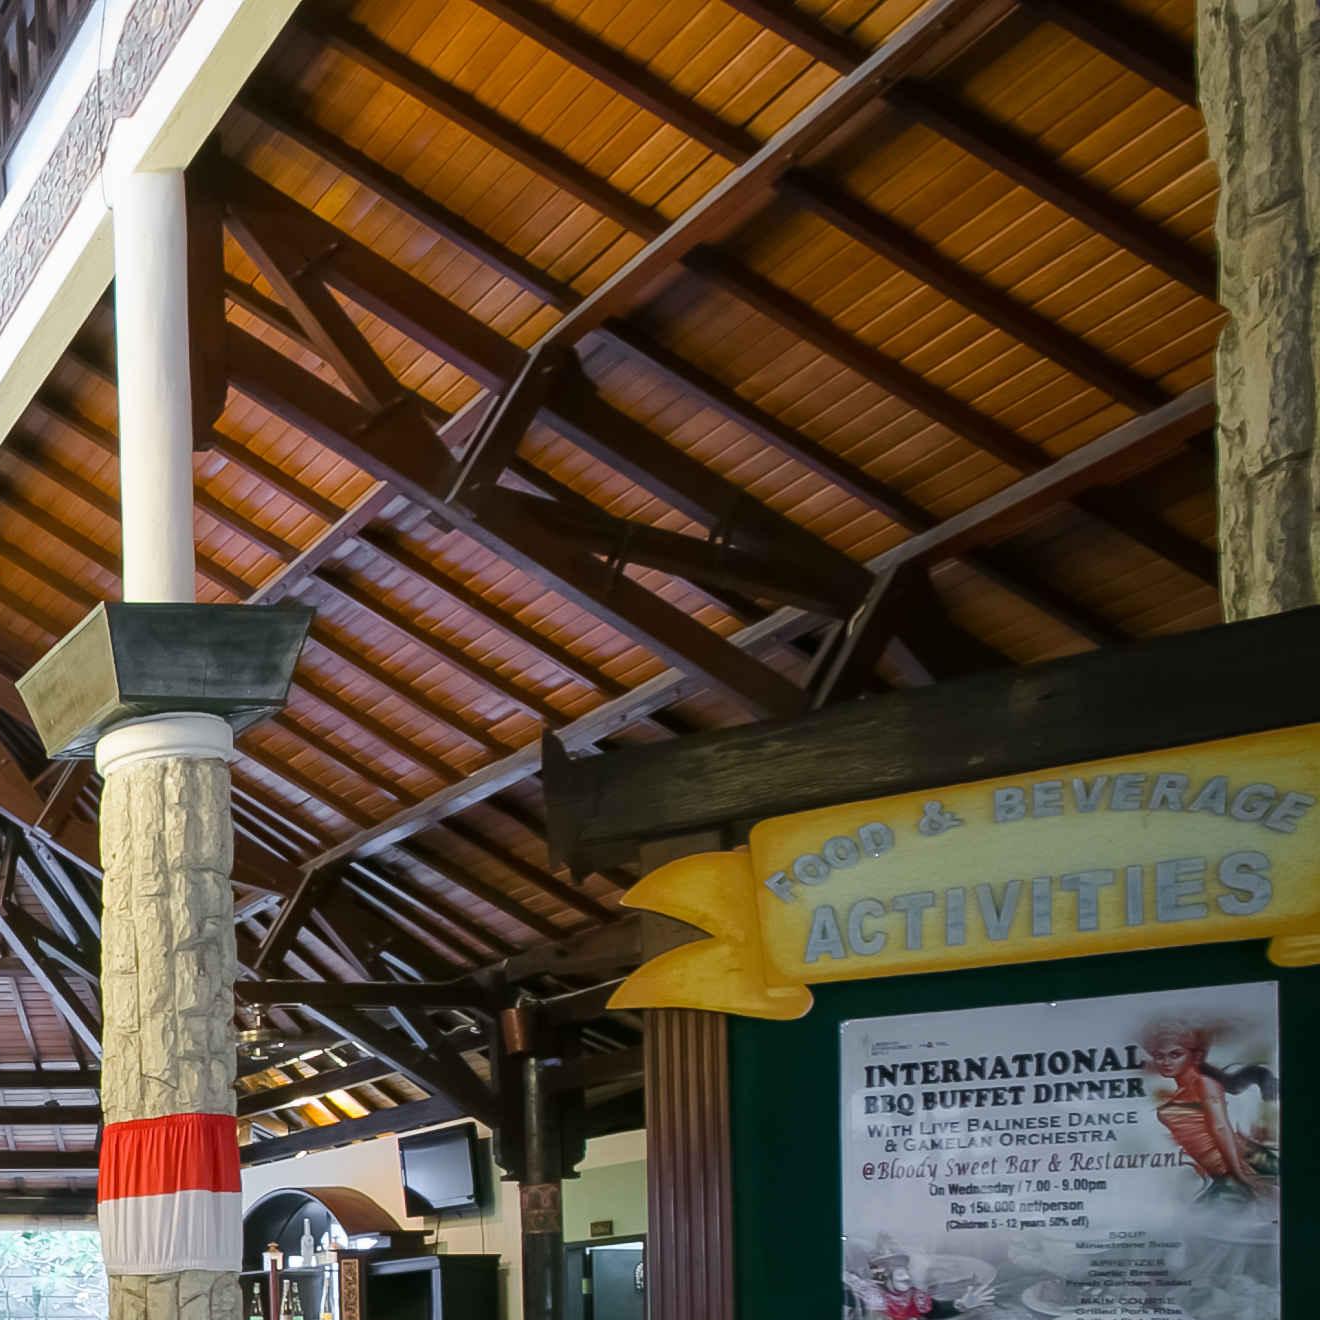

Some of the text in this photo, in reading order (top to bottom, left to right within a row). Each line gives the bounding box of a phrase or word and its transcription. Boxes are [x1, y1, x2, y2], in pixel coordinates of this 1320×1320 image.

[764, 773, 1315, 903] FOOD & BEVERAGE
[804, 850, 1273, 963] ACTIVITIES
[864, 1045, 1145, 1088] INTERNATIONAL
[864, 1077, 1146, 1116] BBQ BUFFET DINNER
[884, 1139, 897, 1153] &
[999, 1130, 1117, 1148] ORCHESTRA
[944, 1157, 998, 1178] Sweet
[1005, 1154, 1039, 1175] Bar
[1047, 1153, 1061, 1173] &
[1069, 1149, 1185, 1172] Restaurant
[950, 1202, 966, 1216] Rp
